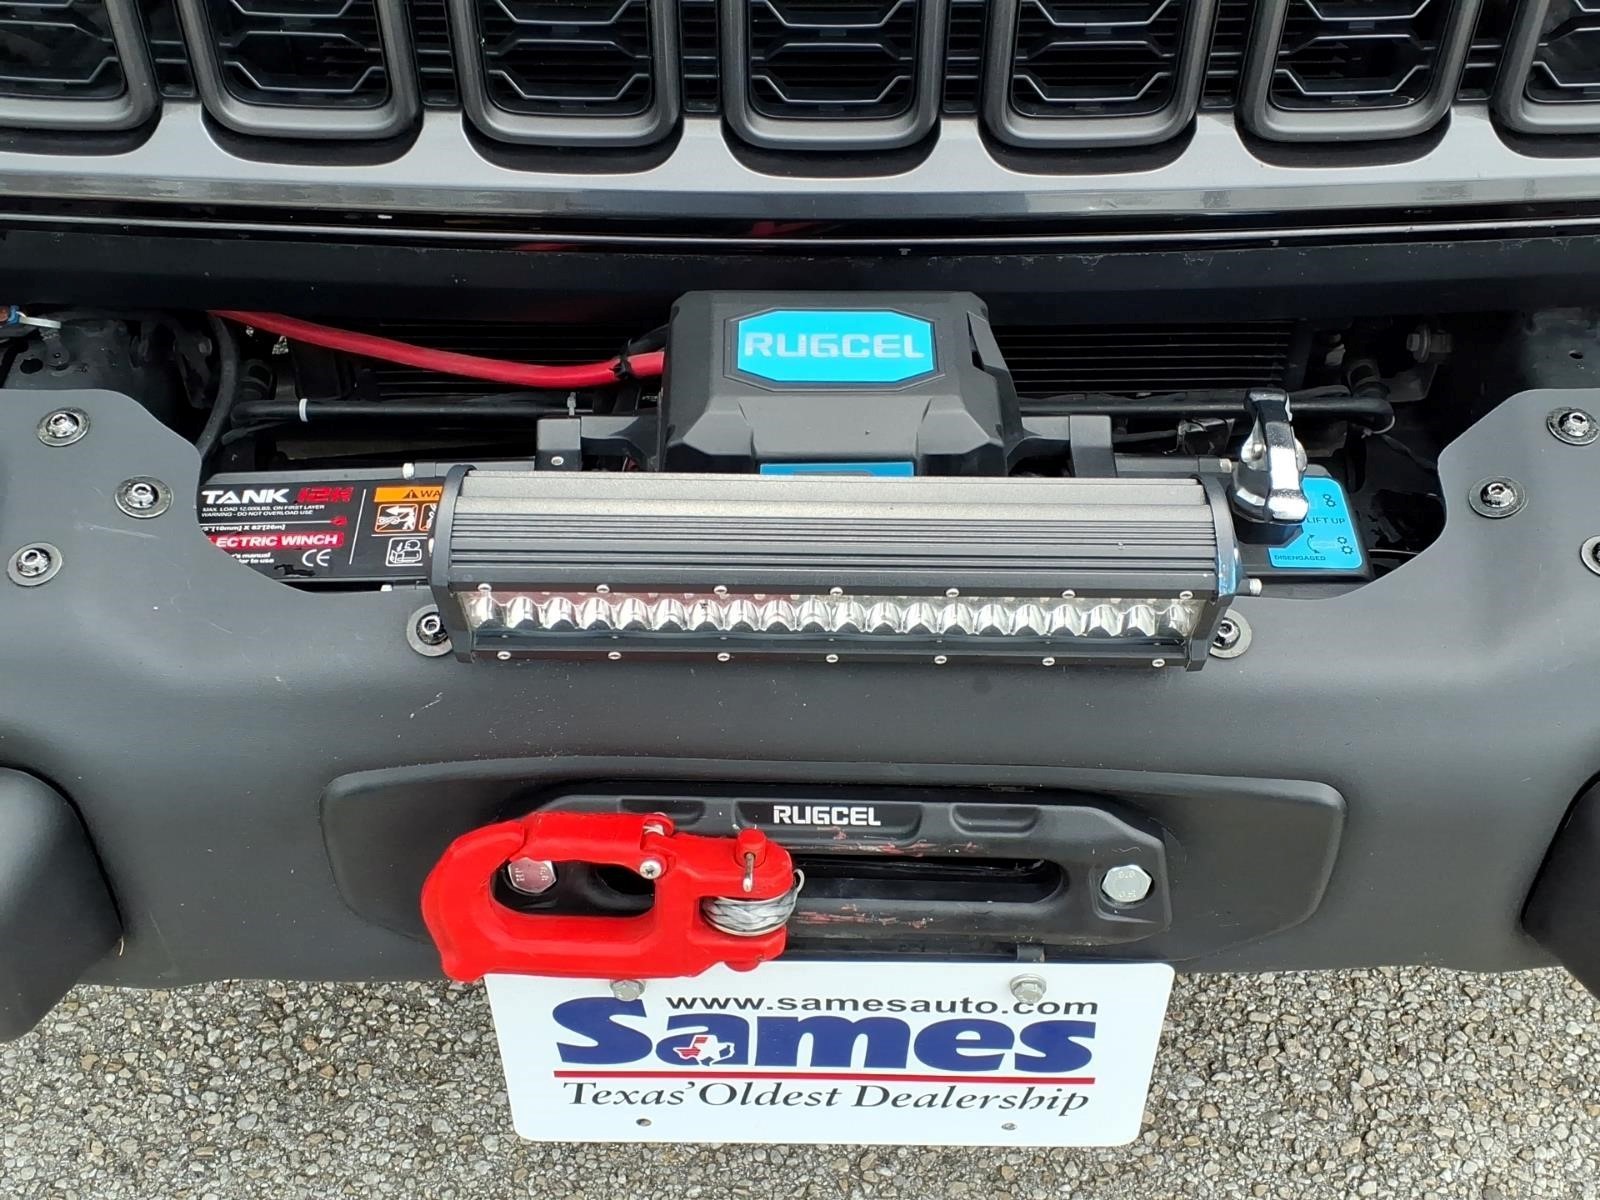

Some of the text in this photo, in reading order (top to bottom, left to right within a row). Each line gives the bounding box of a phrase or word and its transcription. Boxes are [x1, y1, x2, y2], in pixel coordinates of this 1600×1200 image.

[744, 332, 925, 359] RUGCEL
[201, 489, 290, 504] TANK
[210, 534, 338, 547] ECTRIC WINCH
[301, 548, 332, 567] CE
[773, 805, 882, 826] RUGCEL
[665, 996, 1099, 1015] www.samesauto.com
[551, 996, 1097, 1074] Sames
[699, 1082, 843, 1107] Oldest
[850, 1084, 1090, 1117] Dealership
